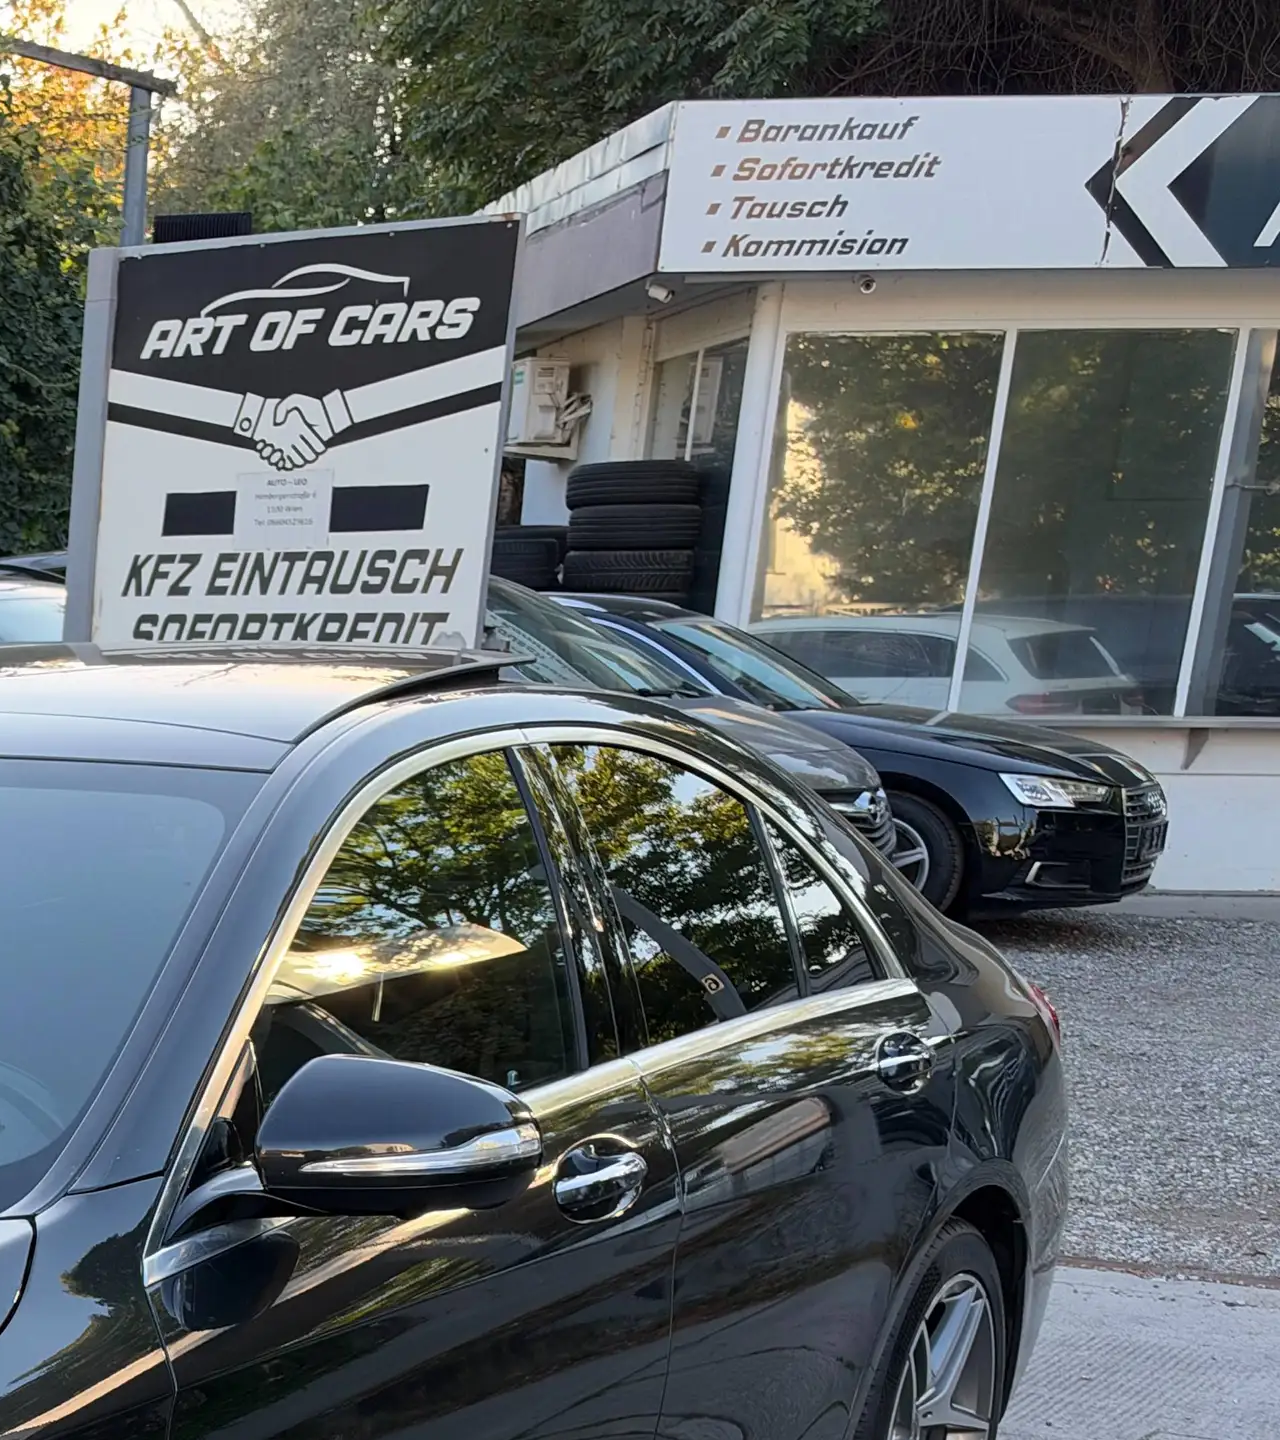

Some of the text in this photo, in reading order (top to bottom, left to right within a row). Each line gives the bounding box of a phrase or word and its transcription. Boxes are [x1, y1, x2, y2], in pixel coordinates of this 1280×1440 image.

[736, 116, 919, 144] Barankauf
[732, 151, 943, 183] Sofortkredit
[730, 194, 848, 221] Tausch
[721, 228, 909, 259] Kommision
[140, 297, 481, 360] ART OF CARS
[121, 547, 465, 598] KFZ EINTAUSCH
